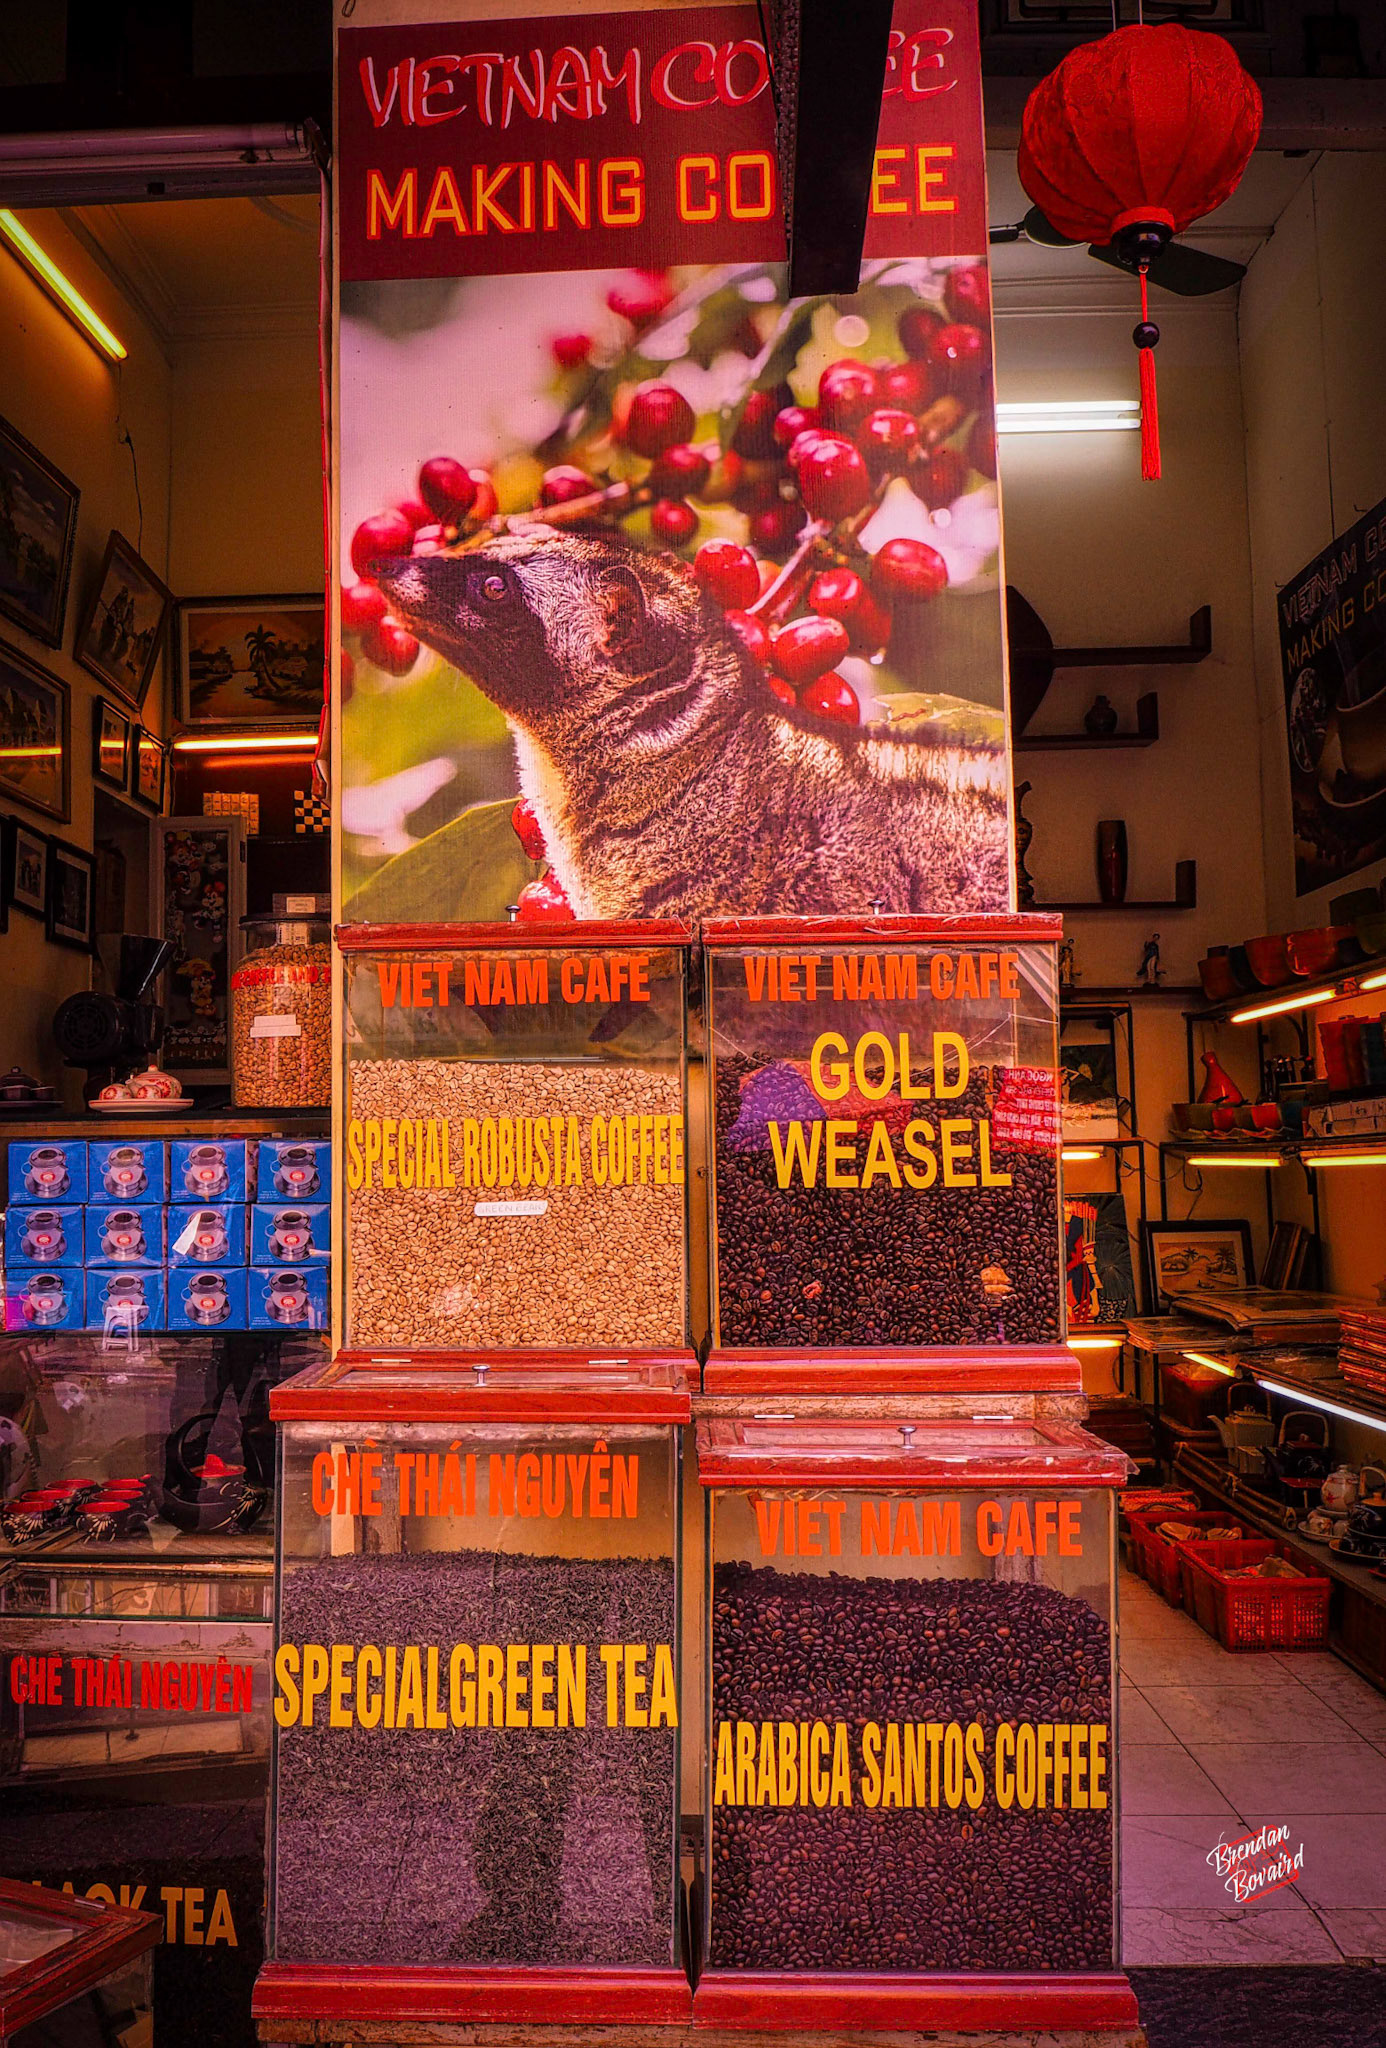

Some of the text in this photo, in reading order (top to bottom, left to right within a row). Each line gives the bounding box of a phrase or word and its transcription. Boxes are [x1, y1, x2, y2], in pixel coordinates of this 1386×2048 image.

[360, 27, 959, 129] VIETNAM COE
[366, 142, 959, 240] MAKING COEE
[1281, 543, 1358, 629] VIETNAM
[1286, 596, 1356, 673] MAKING
[377, 961, 454, 1008] VIET
[464, 958, 549, 1006] NAM
[560, 956, 651, 1004] CAFE
[743, 952, 1021, 1002] VIET NAM CAFE
[810, 1030, 970, 1101] GOLD
[346, 1114, 685, 1189] SPECIAL ROBUSTA COFFEE
[767, 1117, 1013, 1190] WEASEL
[311, 1438, 639, 1519] CHÈ THÁI NGUYÊN
[755, 1500, 1083, 1557] VIET NAM CAFE
[71, 1653, 133, 1709] THÁI
[140, 1654, 253, 1713] NGUYÊN
[600, 1644, 679, 1728] TEA
[714, 1721, 1108, 1810] ARABICA SANTOS COFFEE
[160, 1886, 239, 1947] TEA
